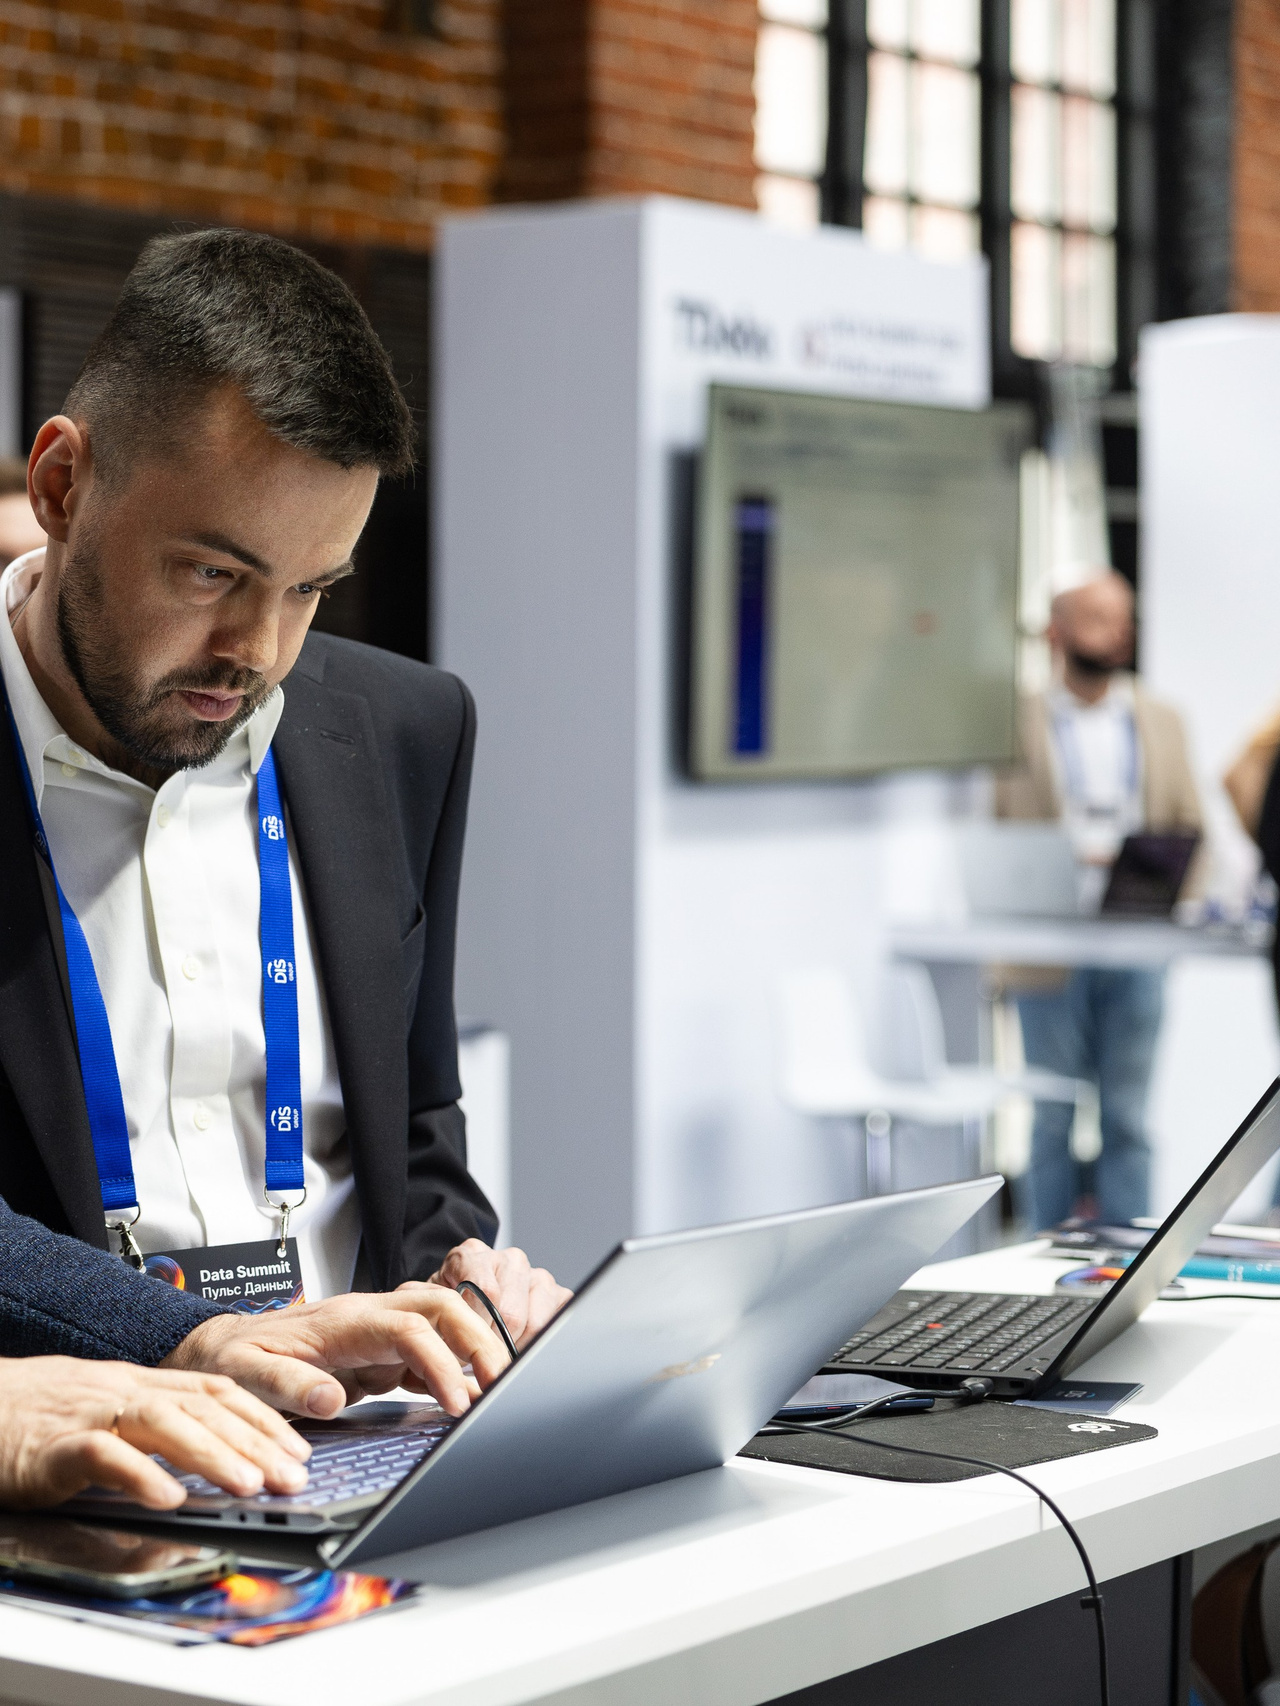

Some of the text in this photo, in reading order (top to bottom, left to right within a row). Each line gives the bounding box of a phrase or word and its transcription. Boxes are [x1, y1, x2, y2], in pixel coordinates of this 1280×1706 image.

[268, 815, 279, 840] DIS
[274, 958, 288, 984] DIS
[278, 1105, 292, 1132] DIS
[200, 1260, 292, 1283] Data Summit
[202, 1280, 294, 1301] Пульс Данных
